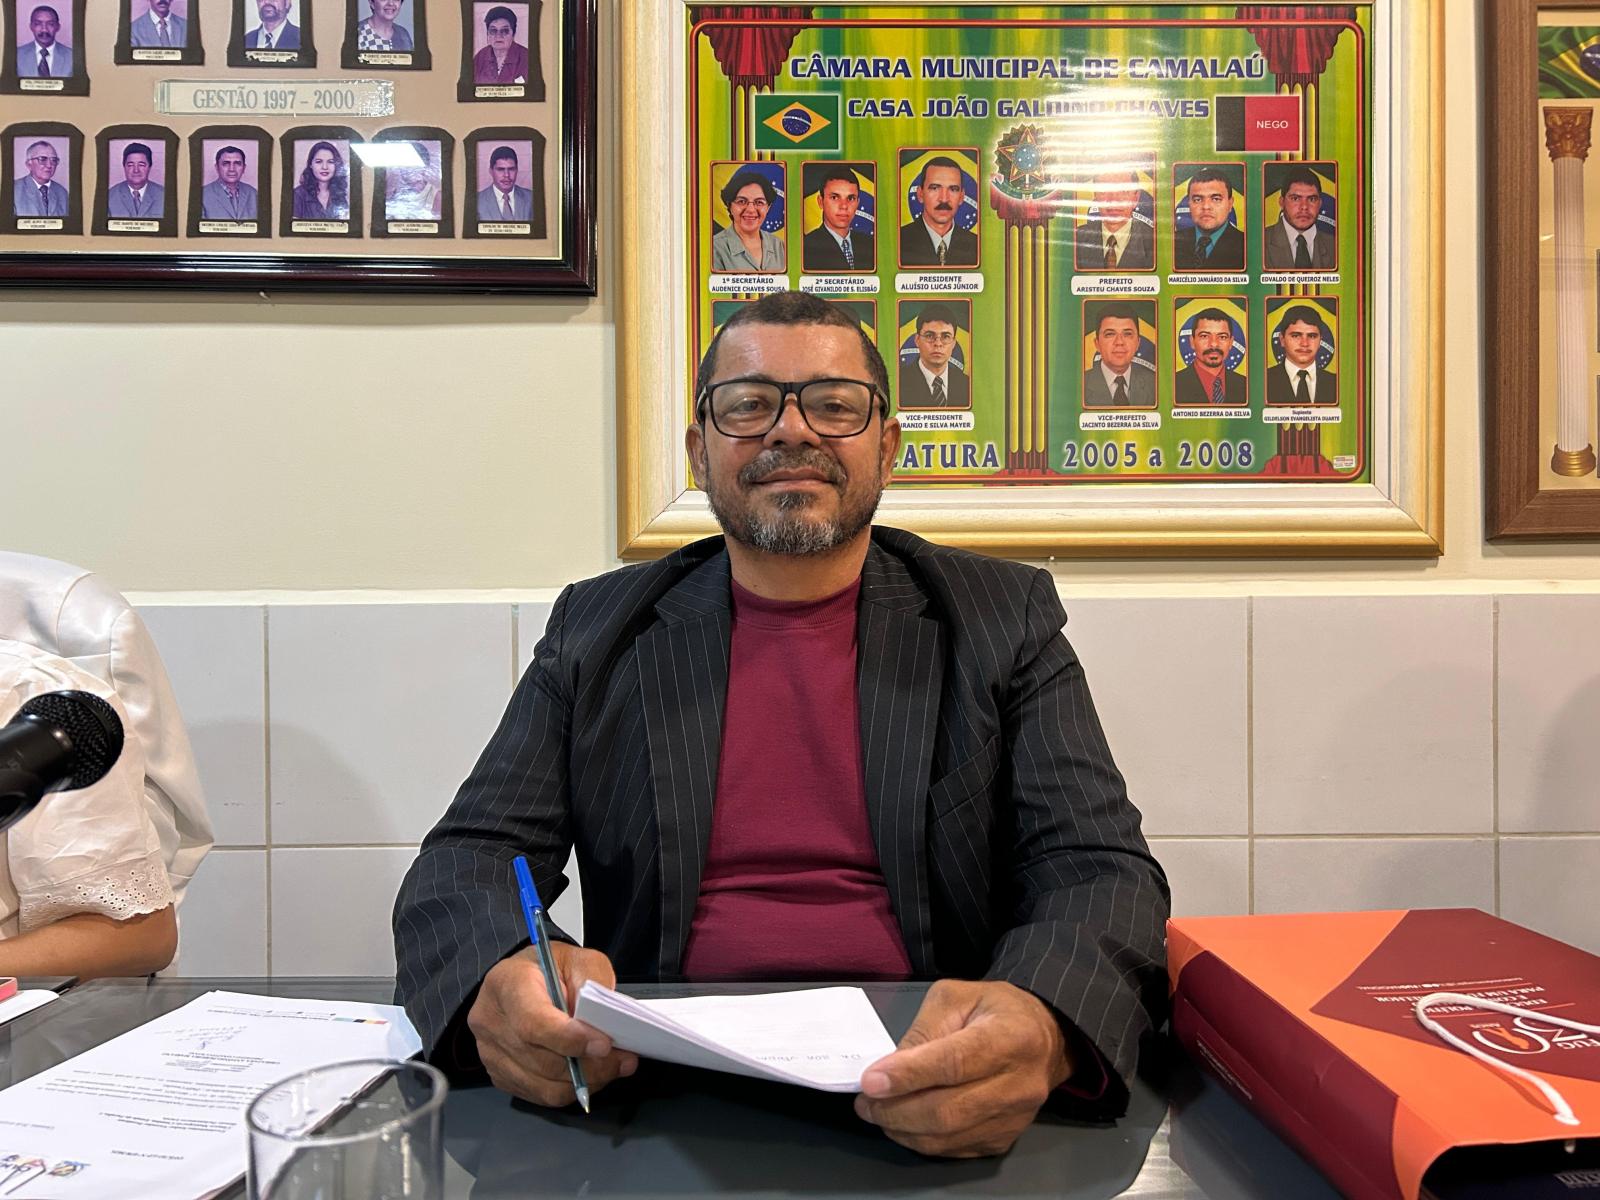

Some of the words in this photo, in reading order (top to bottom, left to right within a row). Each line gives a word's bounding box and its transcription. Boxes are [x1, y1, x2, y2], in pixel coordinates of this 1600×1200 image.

[791, 53, 912, 78] CÂMARA
[922, 58, 1075, 79] MUNICIPAL
[1084, 58, 1119, 79] DE
[1128, 53, 1265, 79] CAMALAÚ
[192, 86, 258, 110] GESTÃO
[262, 90, 297, 110] 1997
[314, 89, 355, 110] 2000
[848, 99, 914, 118] CASA
[922, 95, 988, 118] JOÃO
[997, 99, 1109, 118] GALDINO
[1115, 99, 1209, 118] CHAVES
[1256, 120, 1289, 130] NEGO
[731, 276, 774, 284] SECRETÁRIO
[824, 277, 865, 285] SECRETÁRIO
[919, 275, 962, 283] PRESIDENTE
[1168, 275, 1197, 283] MARICÉLIO
[802, 284, 814, 292] JOSÉ
[901, 282, 928, 290] ALUÍSIO
[954, 281, 979, 290] JÚNIOR
[1065, 442, 1137, 468] 2005
[1149, 449, 1162, 467] a
[1179, 442, 1252, 468] 2008
